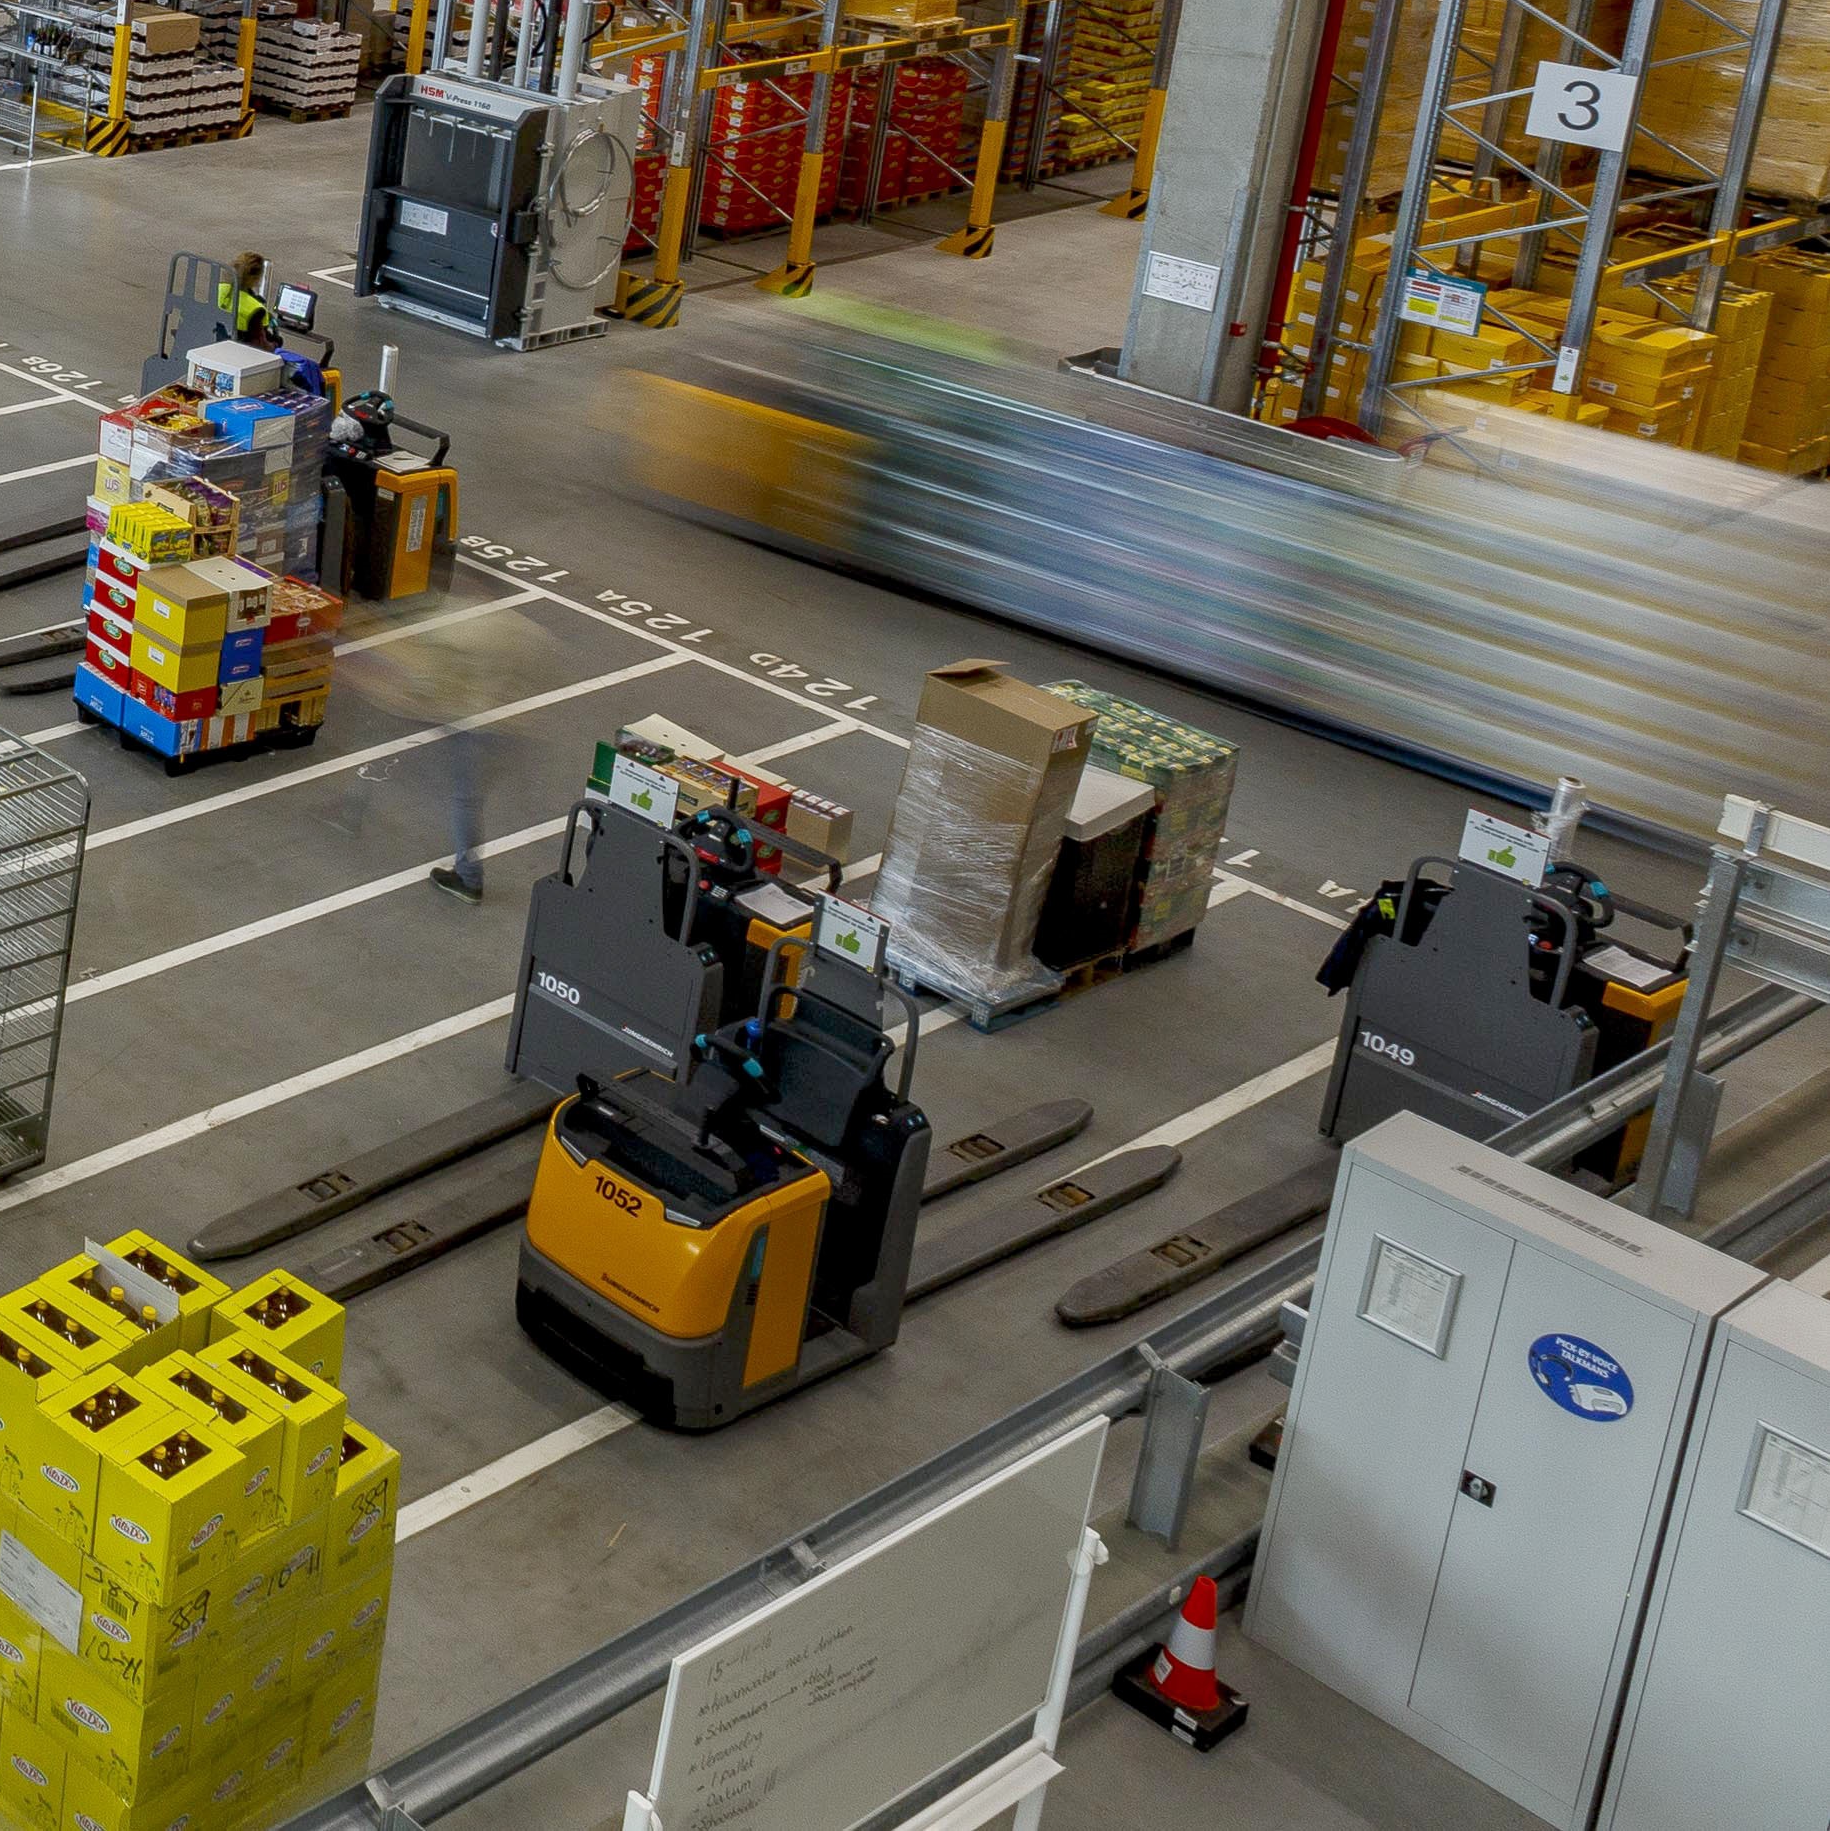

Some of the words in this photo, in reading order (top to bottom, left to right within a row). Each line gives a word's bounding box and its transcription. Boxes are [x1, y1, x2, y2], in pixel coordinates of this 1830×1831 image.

[421, 84, 445, 99] HSM
[474, 100, 491, 110] 1160
[1557, 80, 1601, 132] 3
[21, 355, 103, 390] 126B
[459, 534, 571, 584] 125B
[595, 590, 715, 644] 125A
[749, 652, 880, 711] 124D
[537, 972, 581, 1006] 1050
[622, 1023, 674, 1058] JUNGHEINRICH
[1359, 1030, 1415, 1066] 1049
[594, 1176, 643, 1218] 1052
[1555, 1336, 1618, 1374] PICK-BY-VOICE
[1561, 1349, 1611, 1381] TALKMANS
